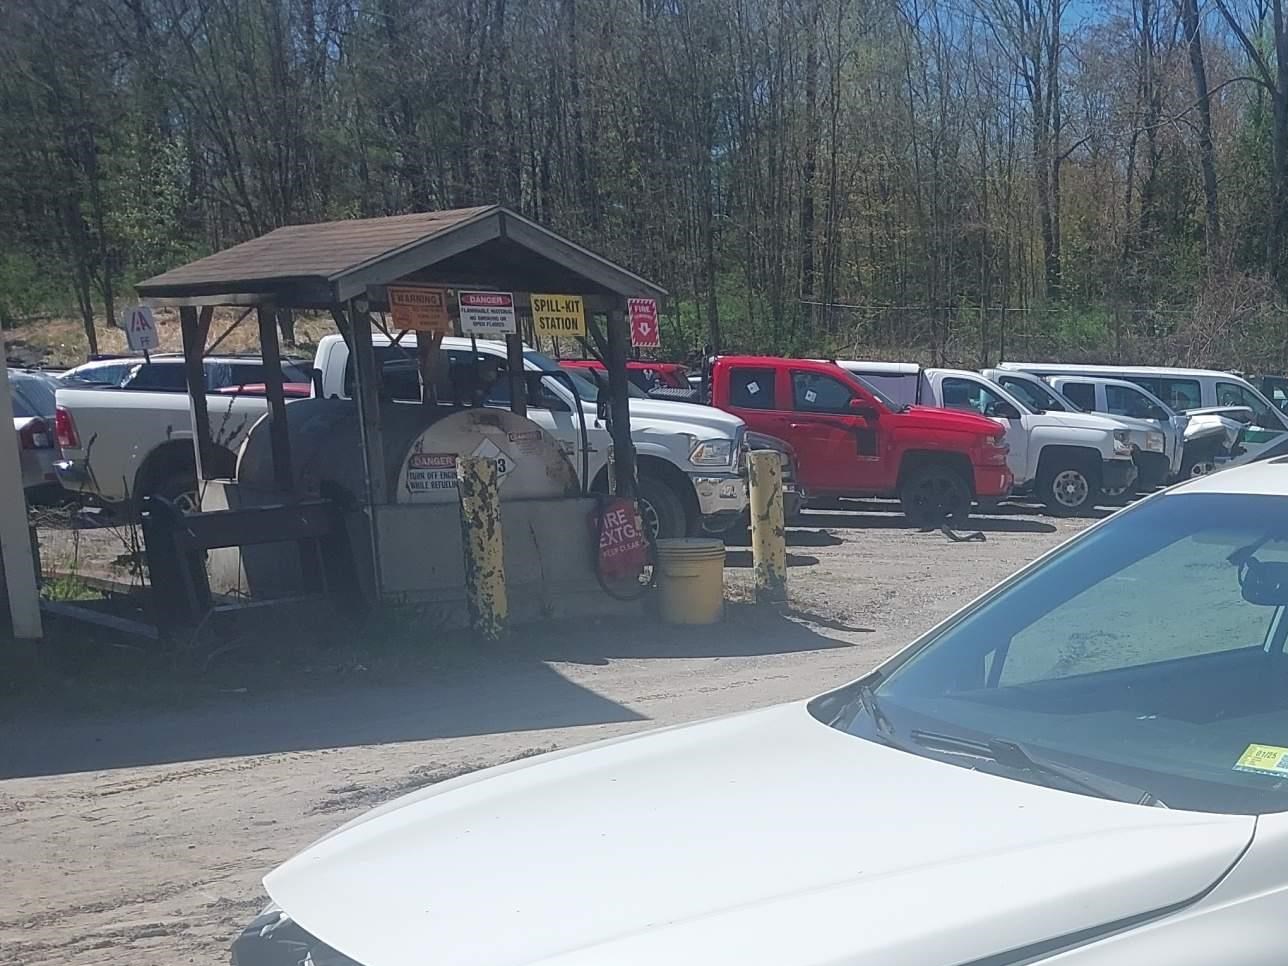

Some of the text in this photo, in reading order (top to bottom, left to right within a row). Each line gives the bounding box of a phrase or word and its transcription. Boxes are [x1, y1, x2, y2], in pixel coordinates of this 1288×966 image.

[397, 294, 438, 305] WARNING
[469, 295, 503, 305] DANGER
[533, 298, 580, 313] SPILL-KIT
[633, 305, 651, 313] FIRE
[539, 316, 579, 331] STATION
[415, 455, 454, 466] DANGER
[410, 471, 425, 480] TURN
[427, 471, 438, 480] OFF
[411, 480, 428, 489] WHILE
